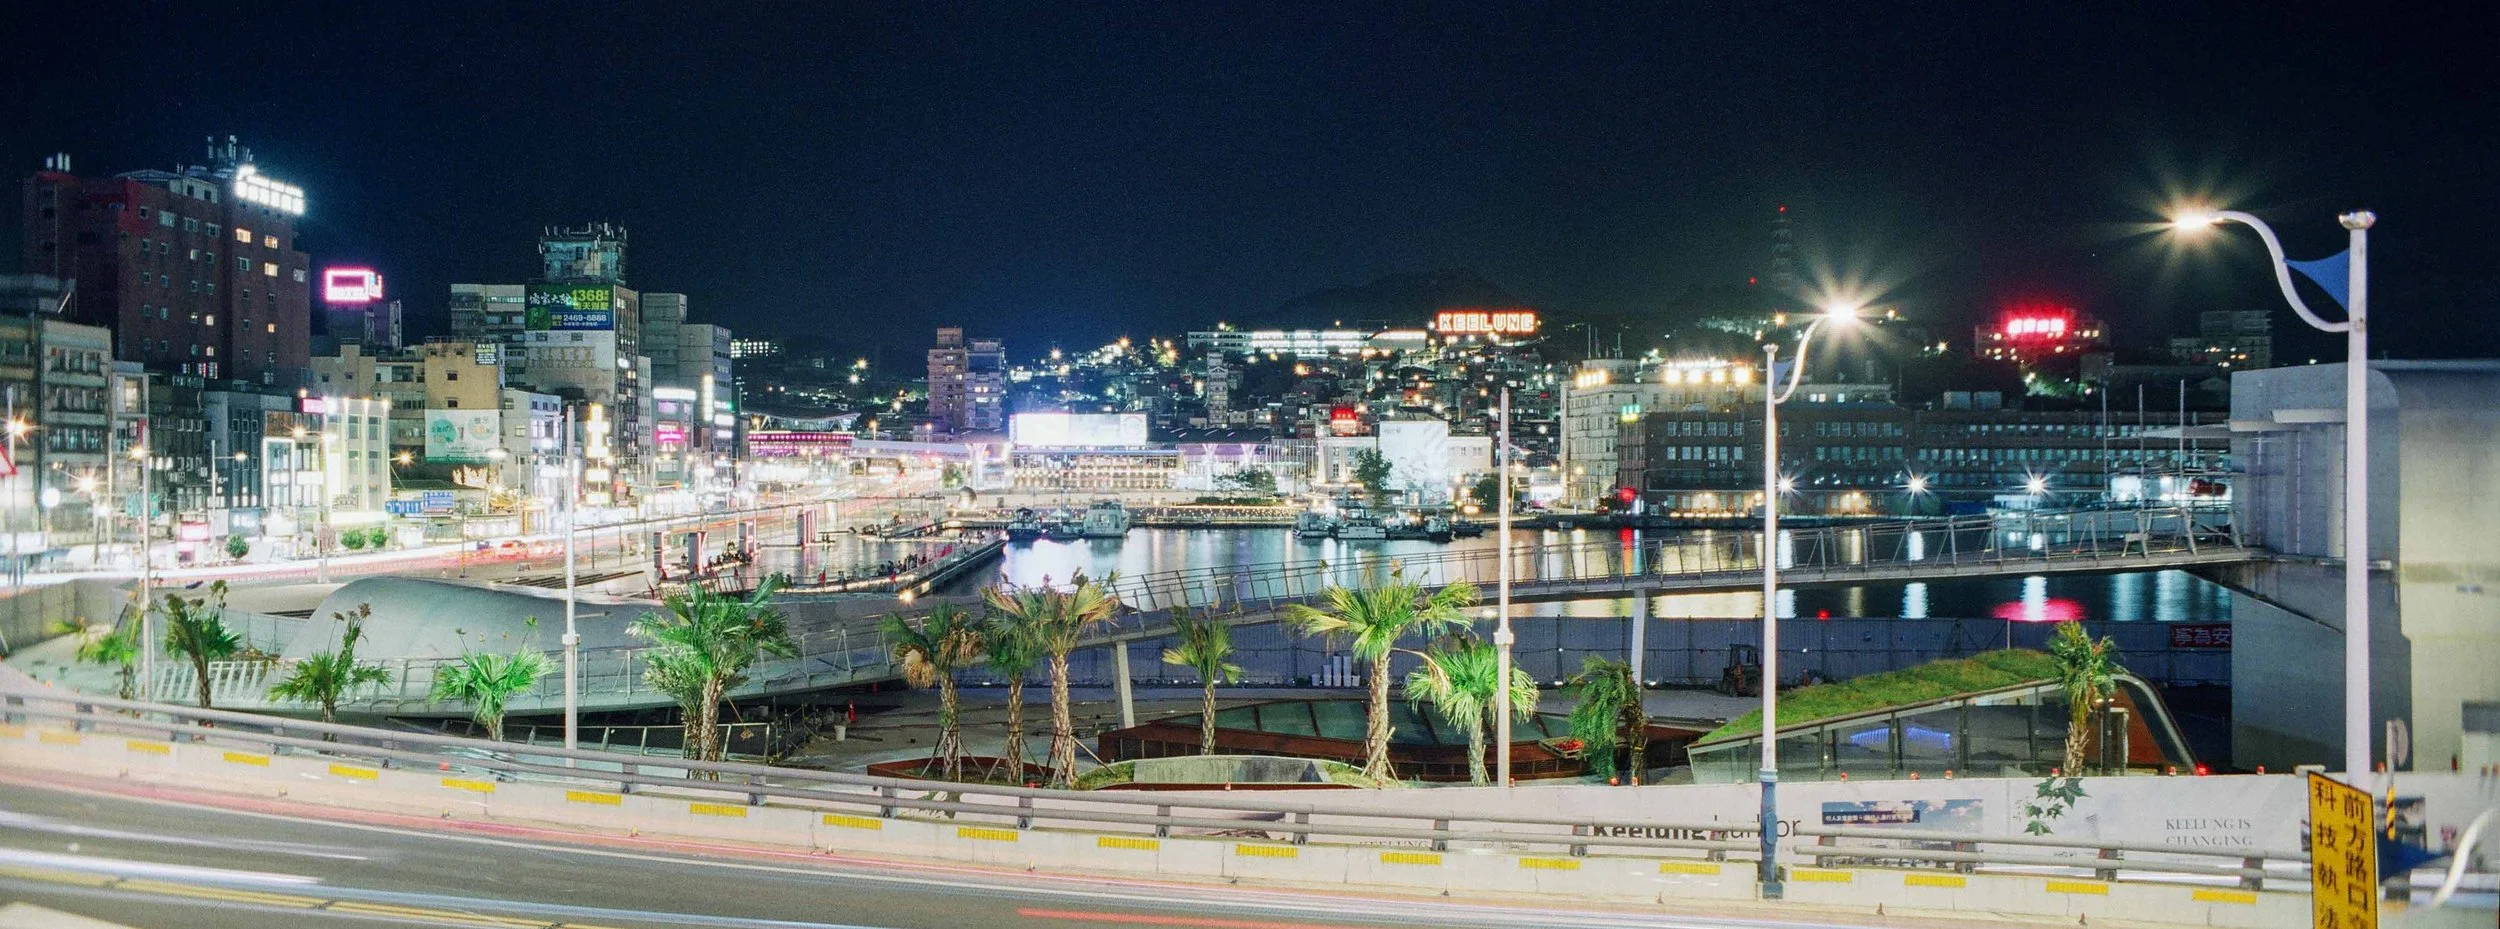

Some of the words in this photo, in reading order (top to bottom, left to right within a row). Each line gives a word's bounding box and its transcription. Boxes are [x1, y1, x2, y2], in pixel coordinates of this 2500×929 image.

[1438, 312, 1535, 332] KEELUNG
[1714, 813, 1801, 838] aror
[2166, 818, 2234, 830] KEELUNG
[2166, 835, 2253, 846] CHANGING
